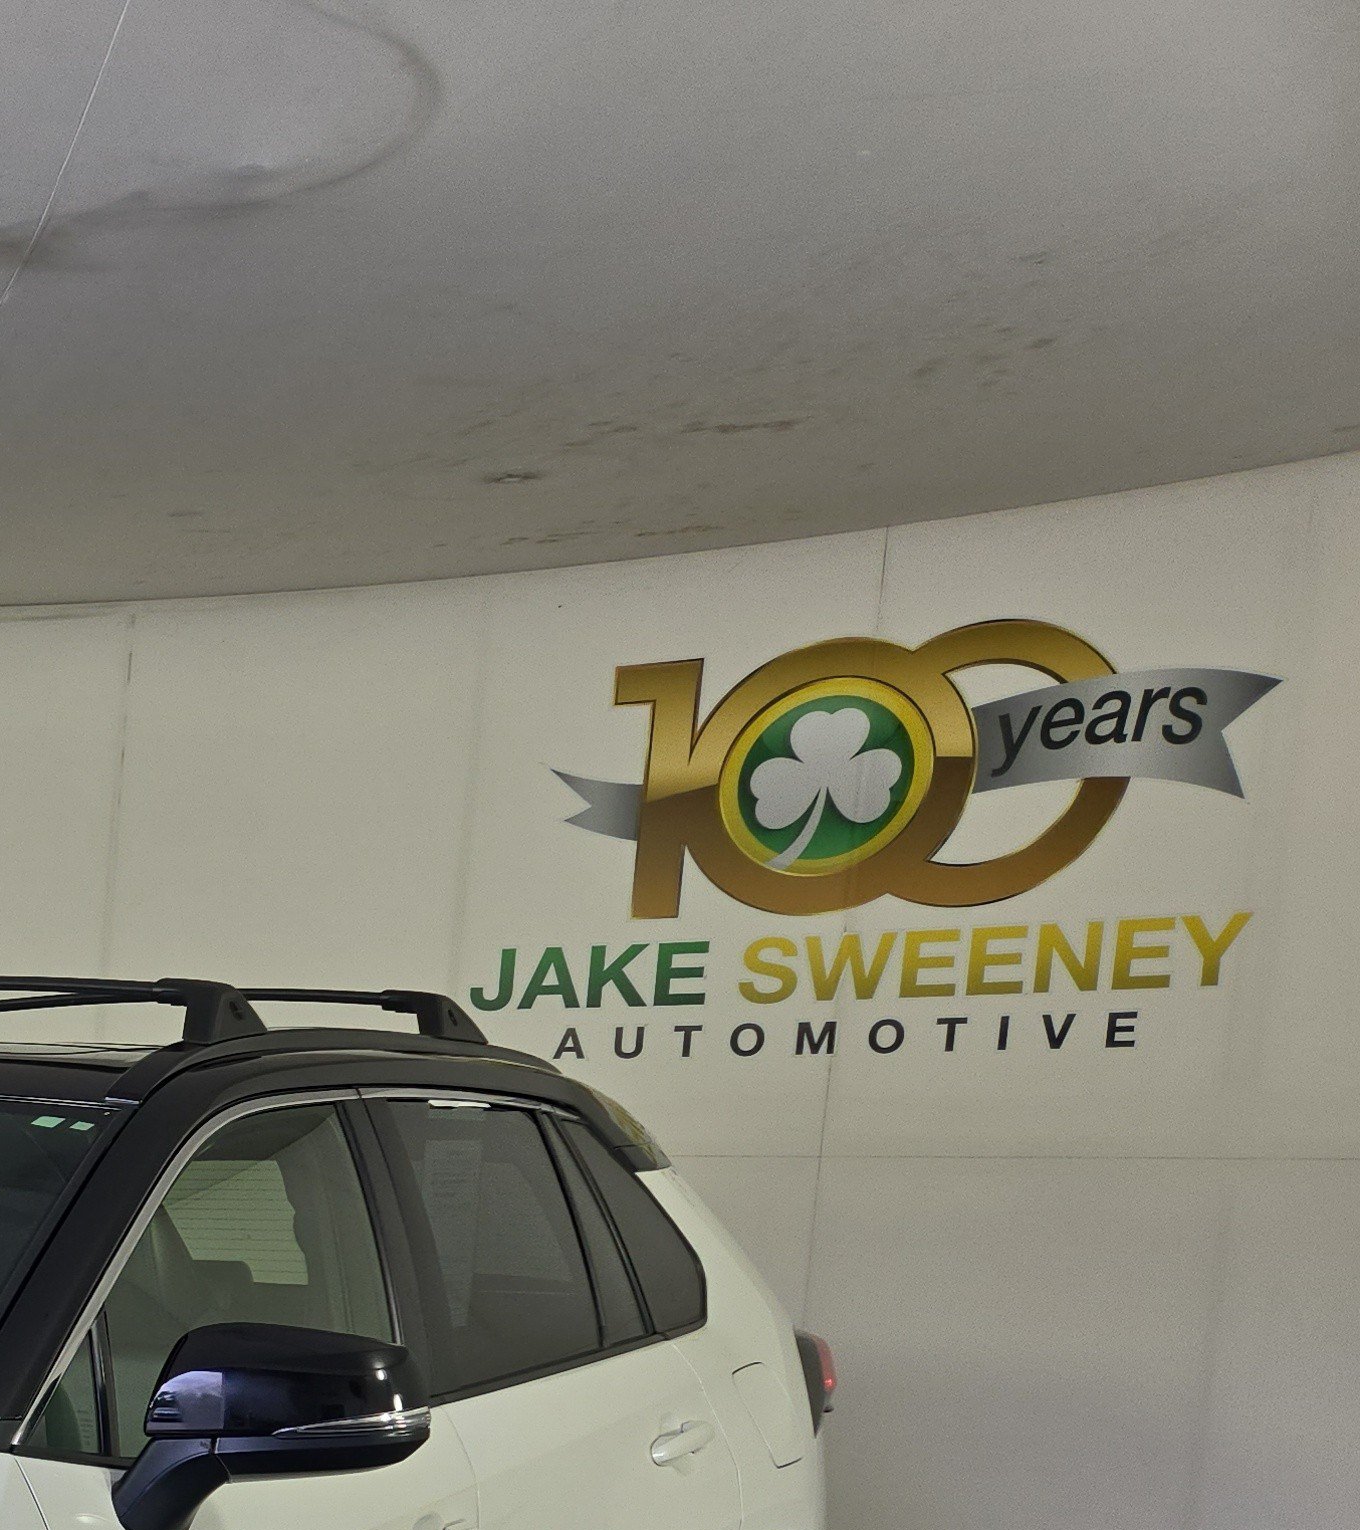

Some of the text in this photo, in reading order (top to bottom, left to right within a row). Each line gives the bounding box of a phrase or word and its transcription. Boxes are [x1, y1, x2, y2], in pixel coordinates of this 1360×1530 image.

[614, 618, 1208, 920] 100 years
[469, 911, 1254, 1011] JAKE SWEENEY
[551, 1010, 1140, 1061] AUTOMOTIVE
